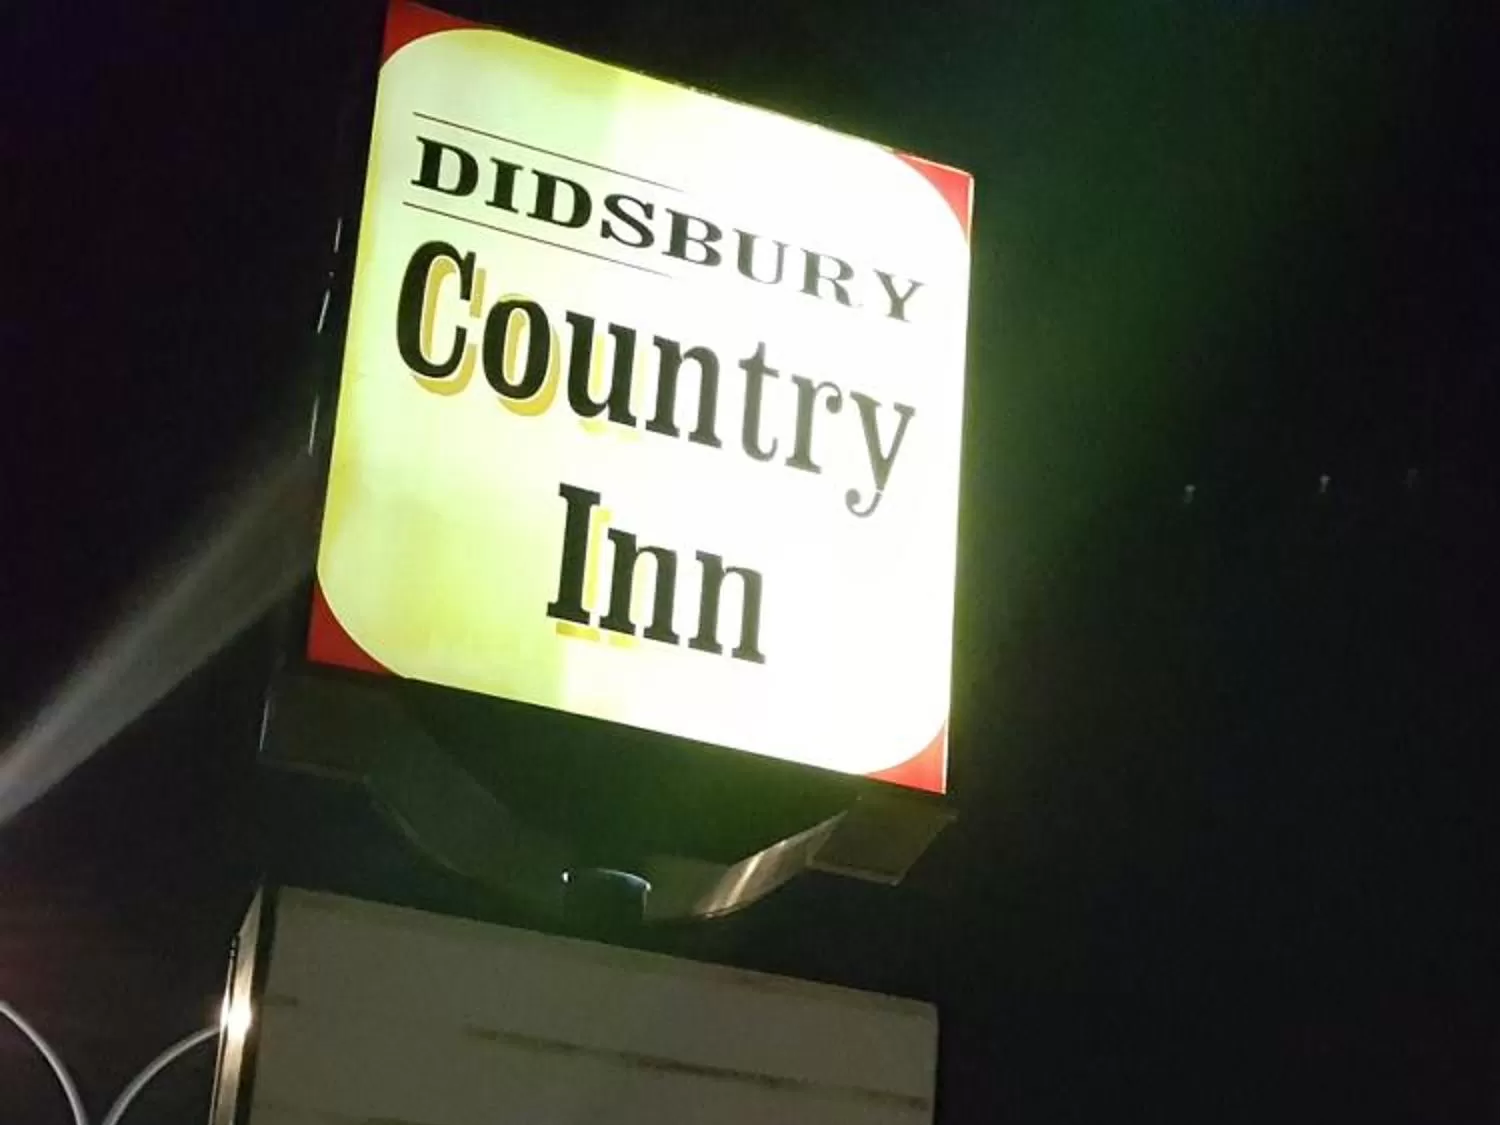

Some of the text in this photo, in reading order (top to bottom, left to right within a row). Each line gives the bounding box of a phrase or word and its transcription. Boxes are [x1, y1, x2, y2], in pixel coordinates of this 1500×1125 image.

[410, 136, 925, 323] DIDSBURY
[395, 240, 917, 518] Country
[546, 482, 766, 664] Inn
